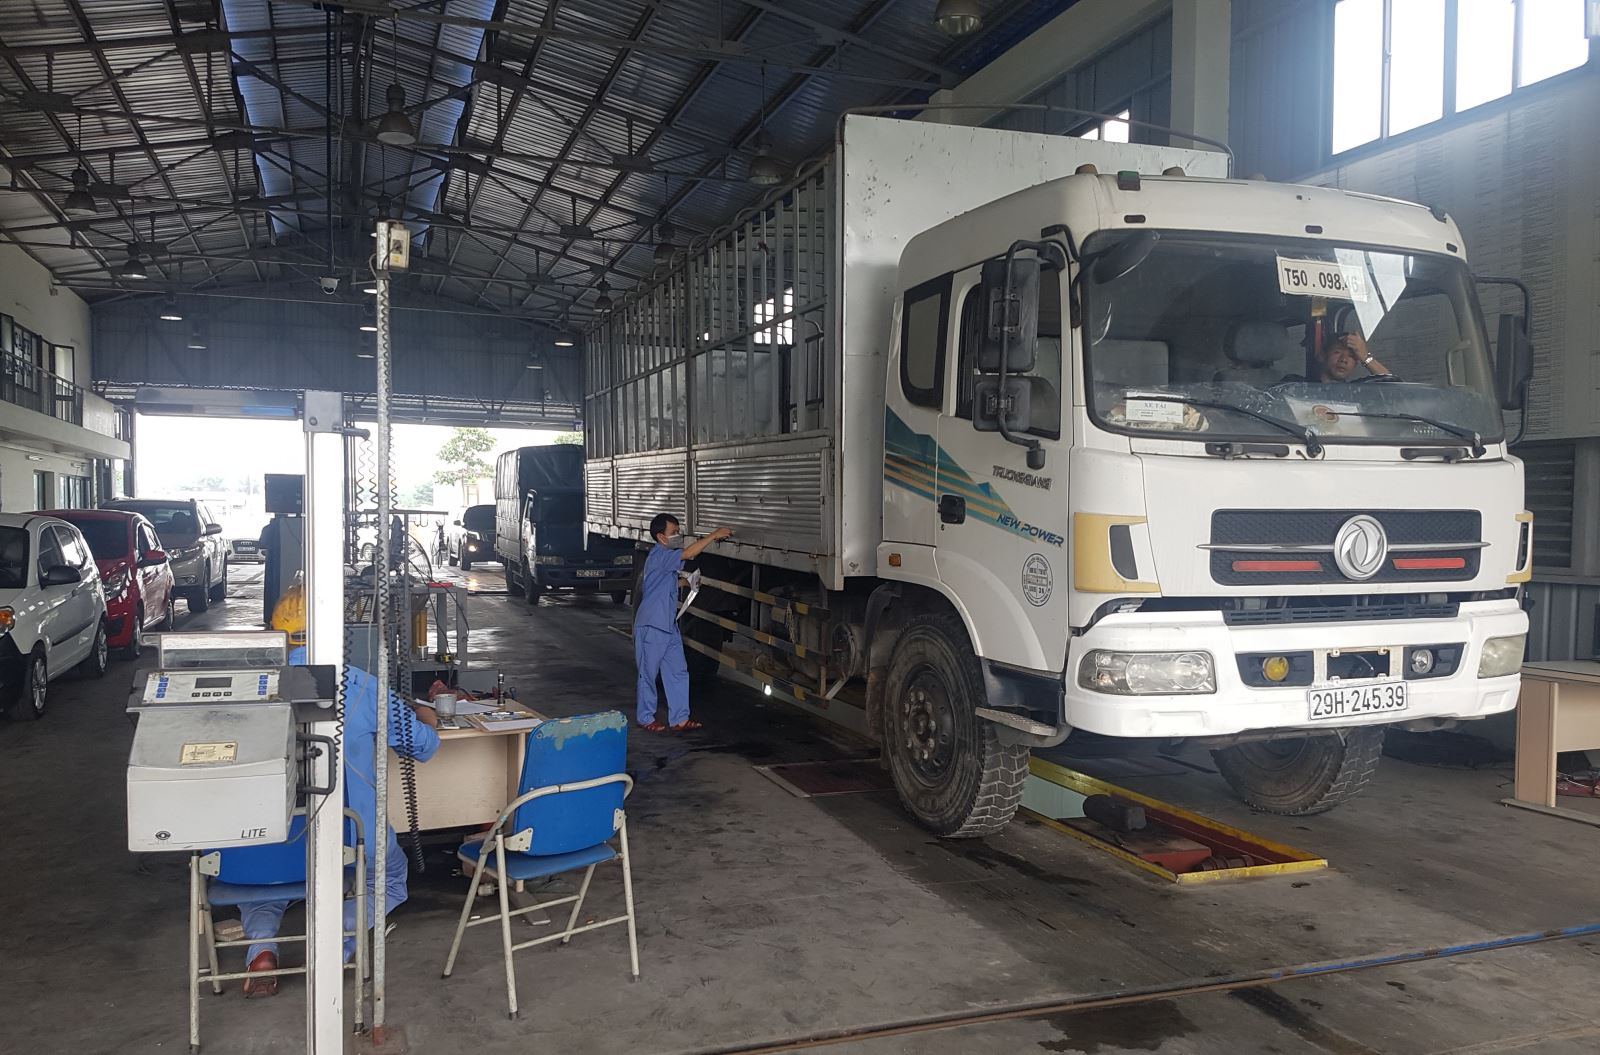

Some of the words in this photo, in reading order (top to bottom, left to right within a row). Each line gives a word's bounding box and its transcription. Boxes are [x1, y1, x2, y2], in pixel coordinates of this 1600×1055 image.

[997, 514, 1021, 530] NEW
[1021, 523, 1064, 547] POWER
[1313, 686, 1405, 716] 29H-245.39
[241, 828, 267, 839] LITE
